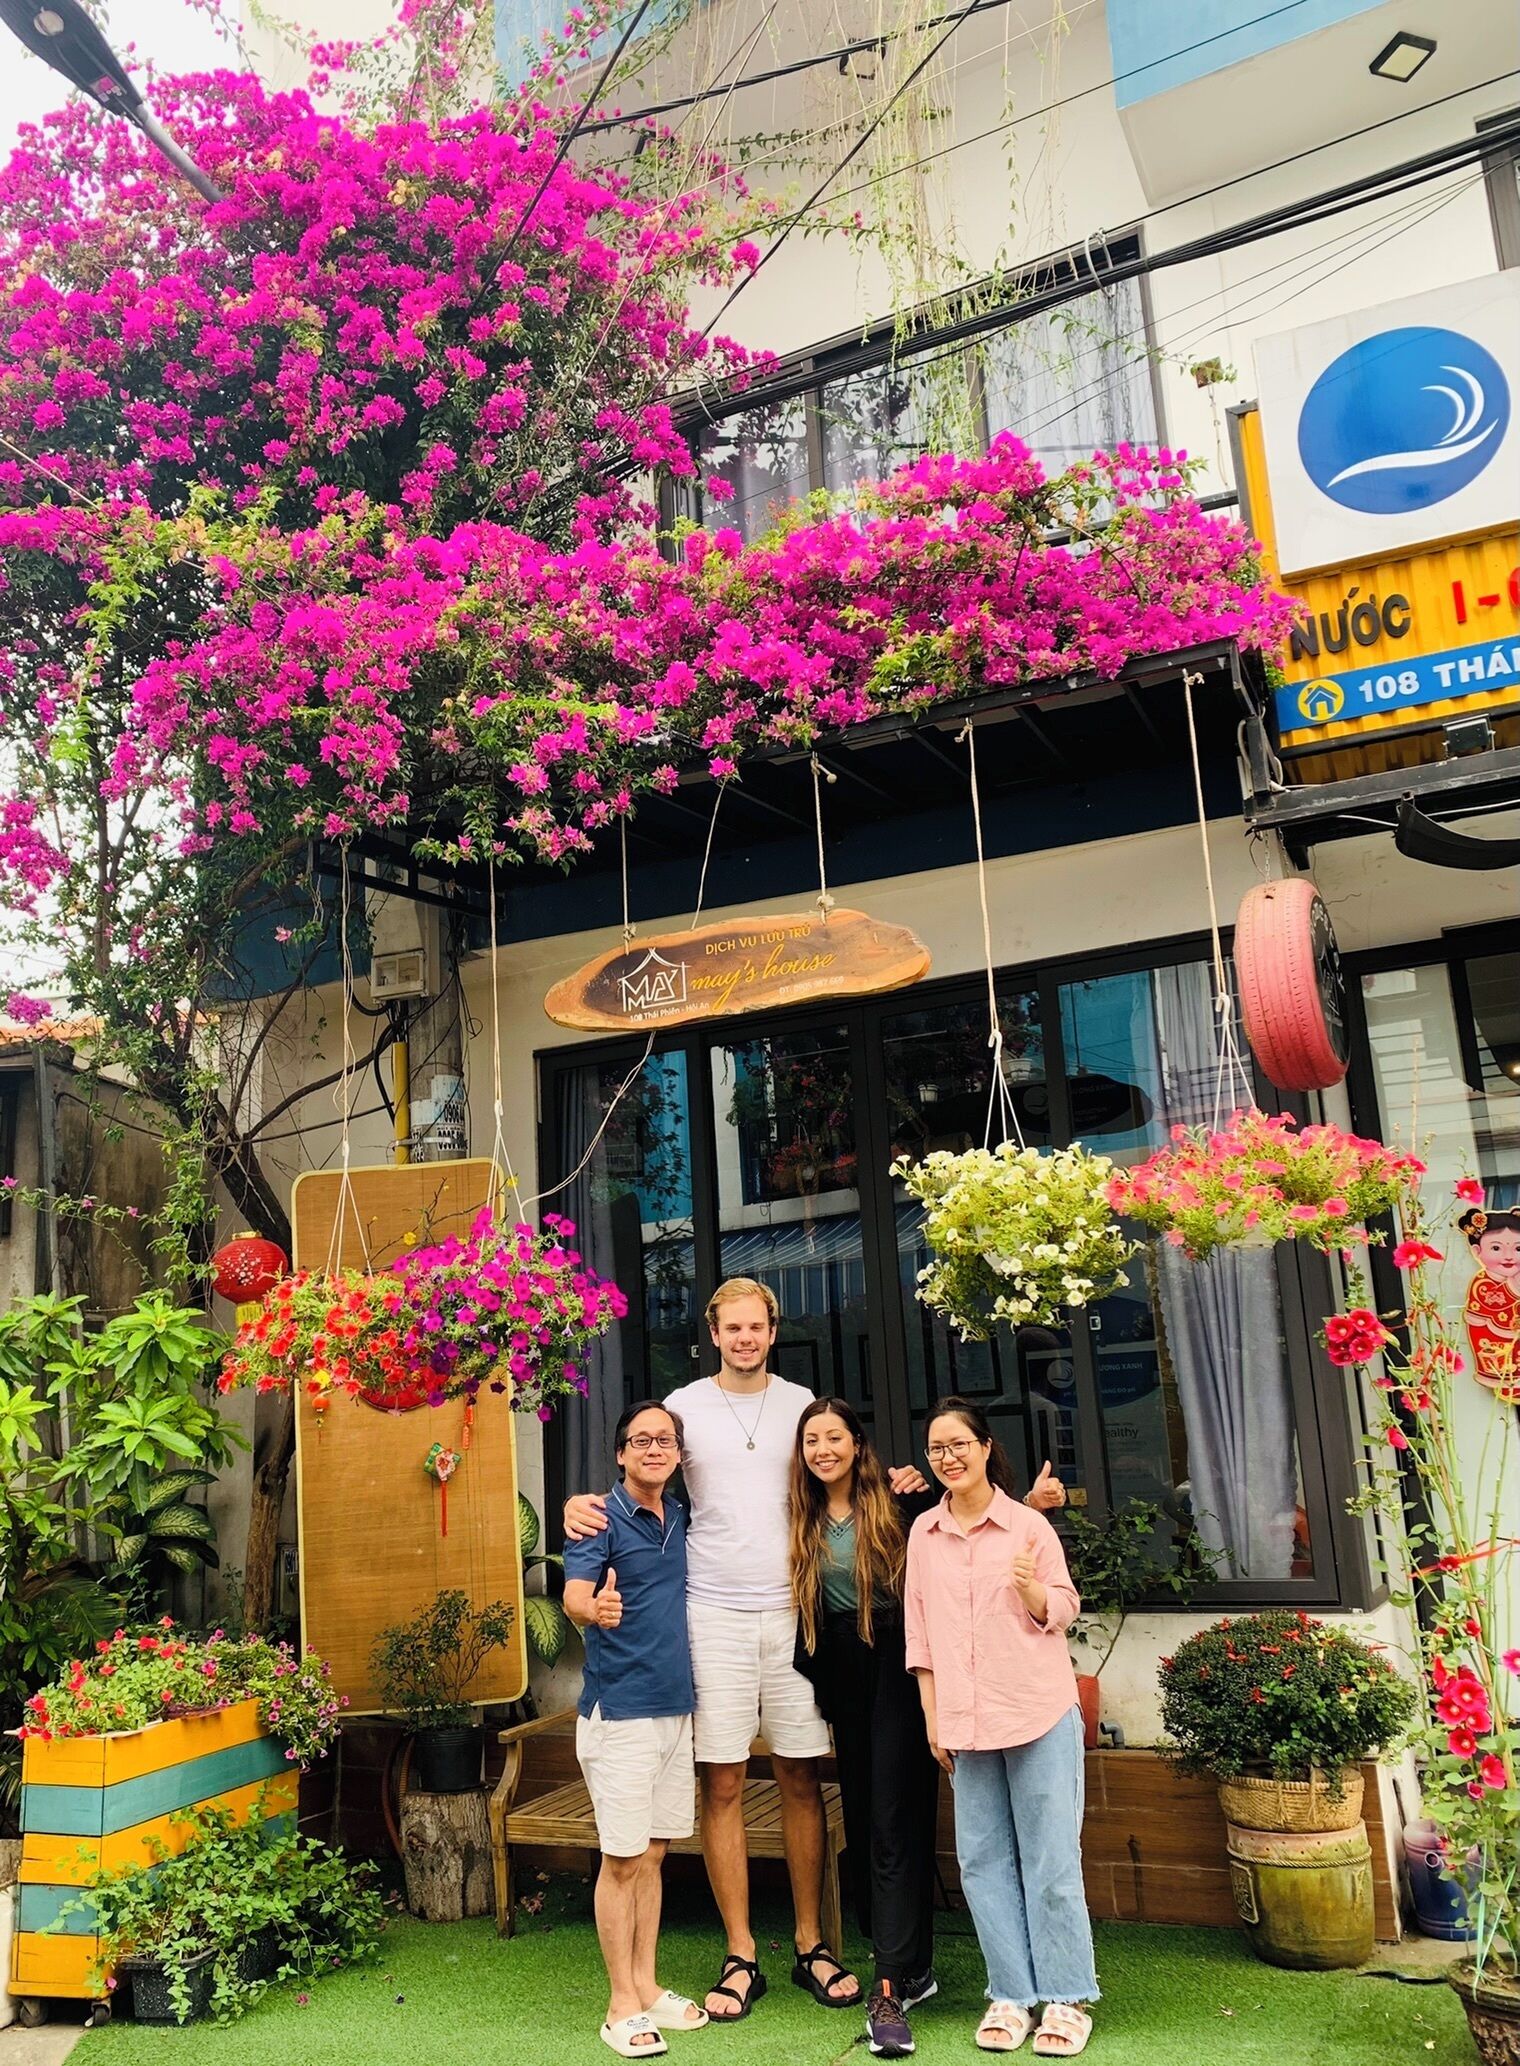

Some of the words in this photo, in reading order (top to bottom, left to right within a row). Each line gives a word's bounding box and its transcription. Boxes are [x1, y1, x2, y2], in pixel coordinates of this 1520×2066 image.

[1292, 586, 1411, 661] NƯỚC
[1358, 670, 1420, 703] 108
[690, 960, 758, 1011] may's
[762, 943, 837, 980] house
[1104, 1426, 1138, 1439] ealthy
